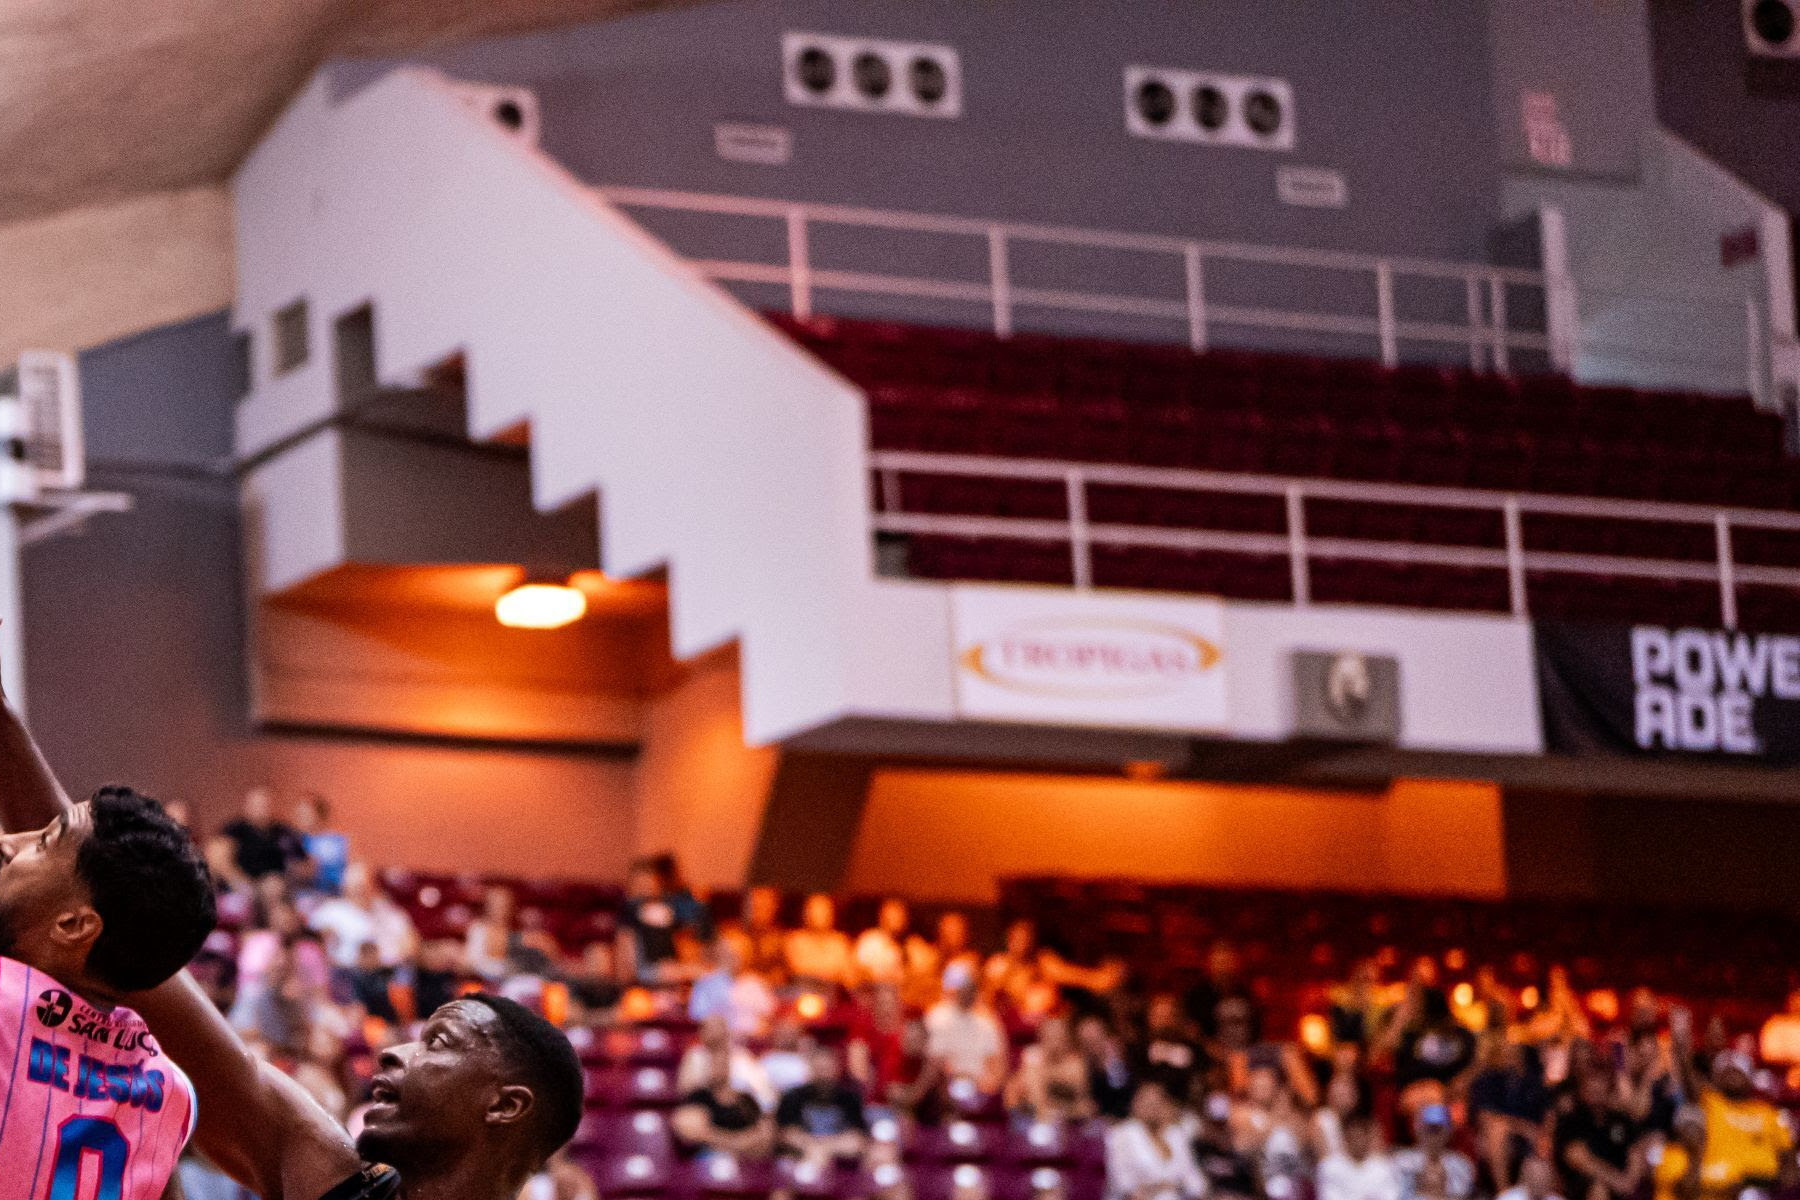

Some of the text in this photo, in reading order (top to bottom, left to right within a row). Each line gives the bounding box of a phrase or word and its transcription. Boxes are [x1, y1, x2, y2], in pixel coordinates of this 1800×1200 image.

[1635, 686, 1760, 755] ADE
[67, 1013, 109, 1044] SAN
[27, 1035, 71, 1093] DE
